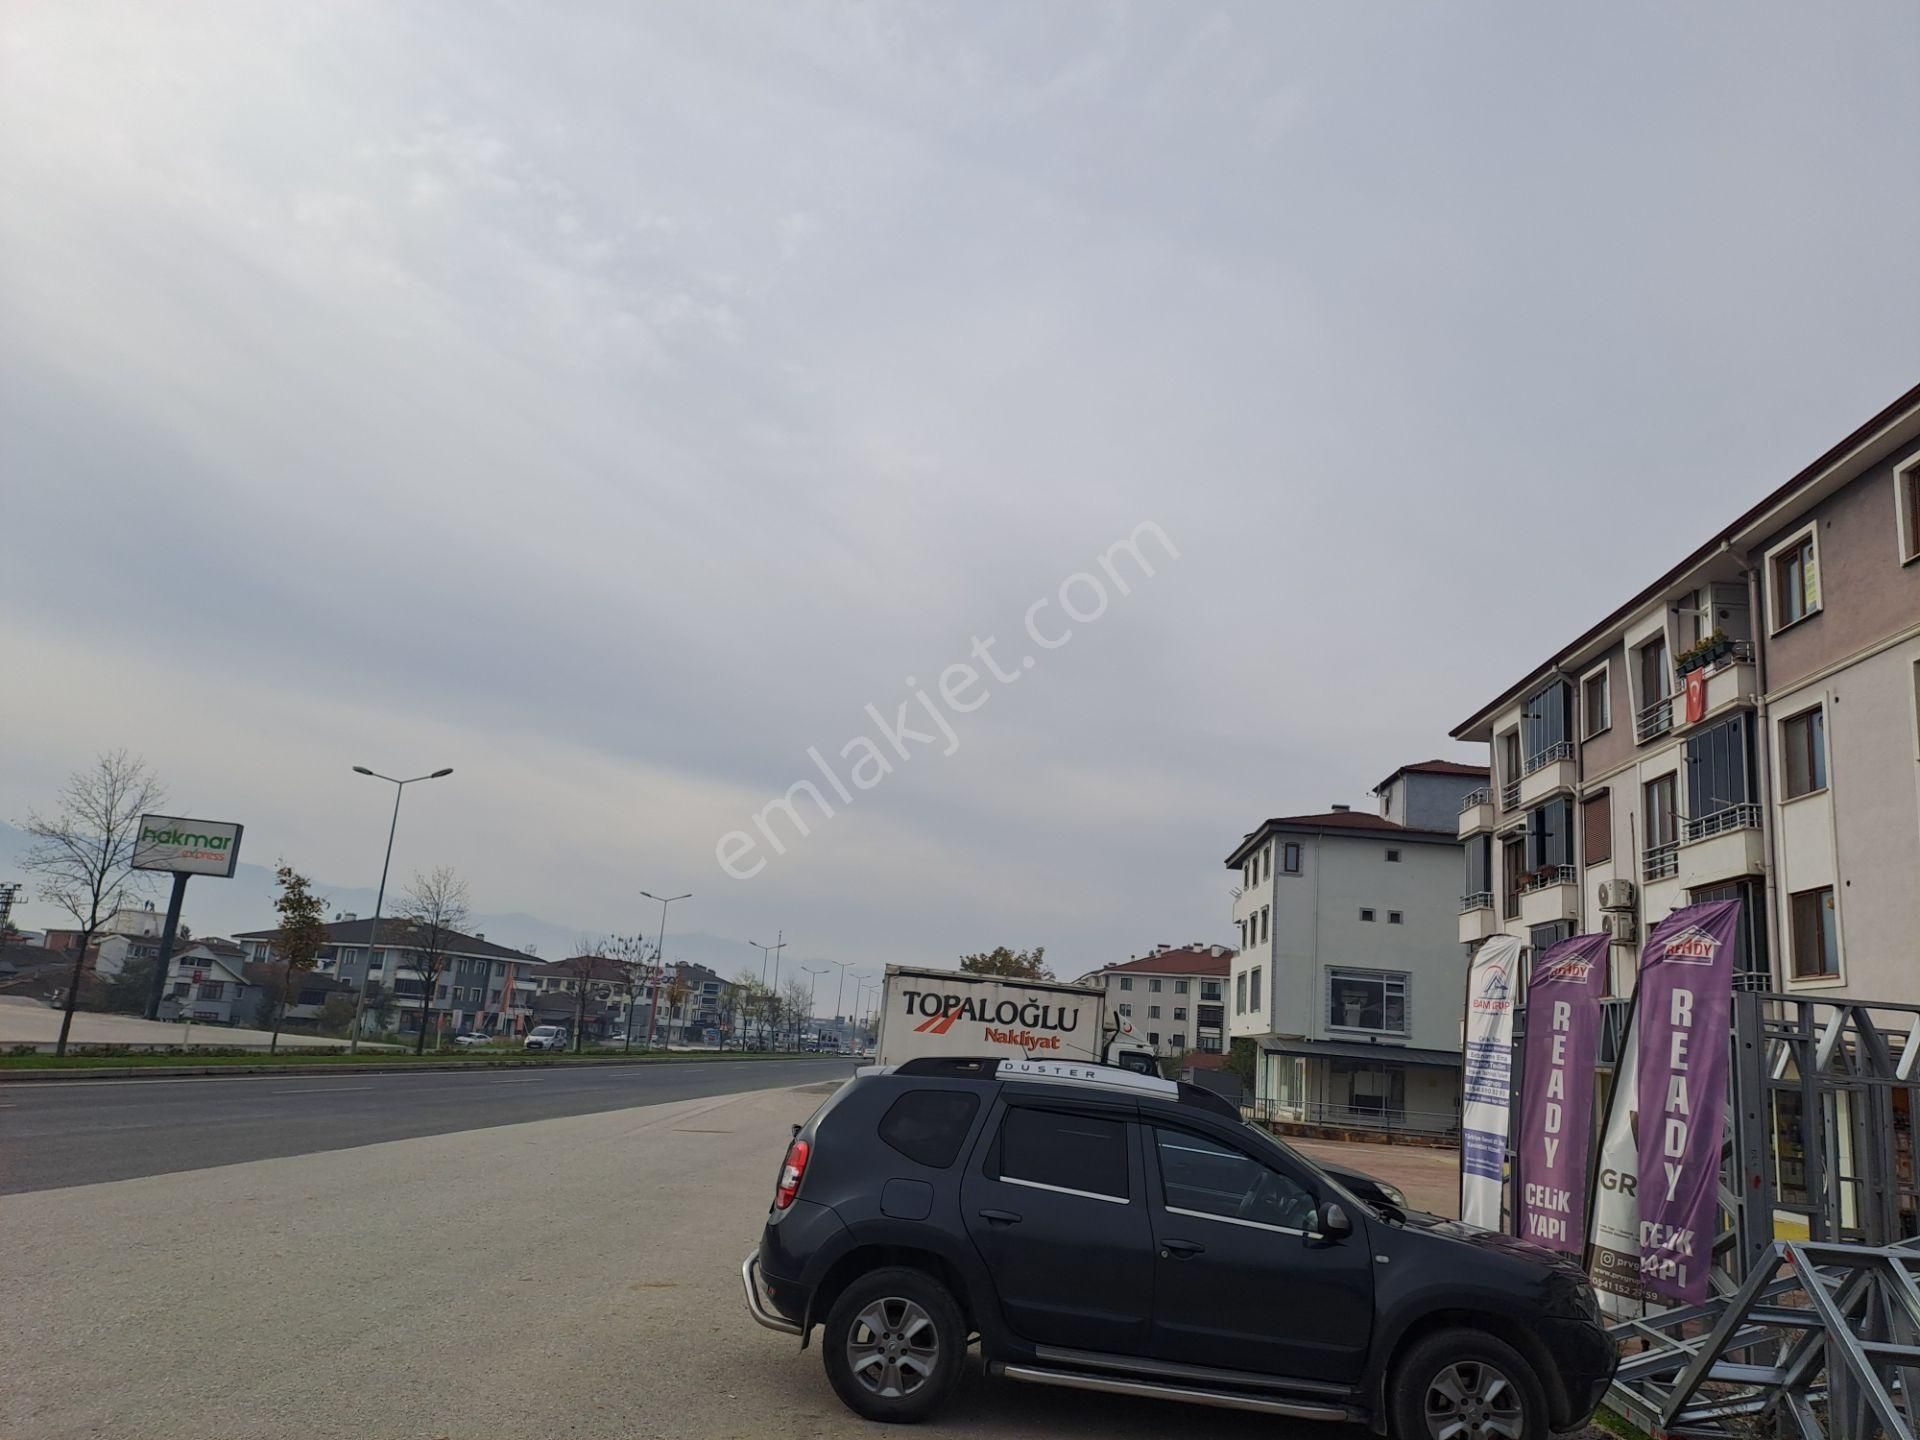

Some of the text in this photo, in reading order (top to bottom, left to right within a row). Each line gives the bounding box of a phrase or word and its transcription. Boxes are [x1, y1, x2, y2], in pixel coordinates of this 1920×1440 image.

[142, 826, 232, 851] hakmar
[903, 991, 1079, 1032] TOPALOĞLU
[984, 1026, 1061, 1051] Nakliyat
[1004, 1063, 1096, 1079] DUSTER
[1544, 1000, 1572, 1169] READY
[1664, 988, 1694, 1202] READY
[1600, 1168, 1638, 1198] GR
[1529, 1212, 1567, 1242] YAPI
[1617, 1258, 1640, 1272] prvg
